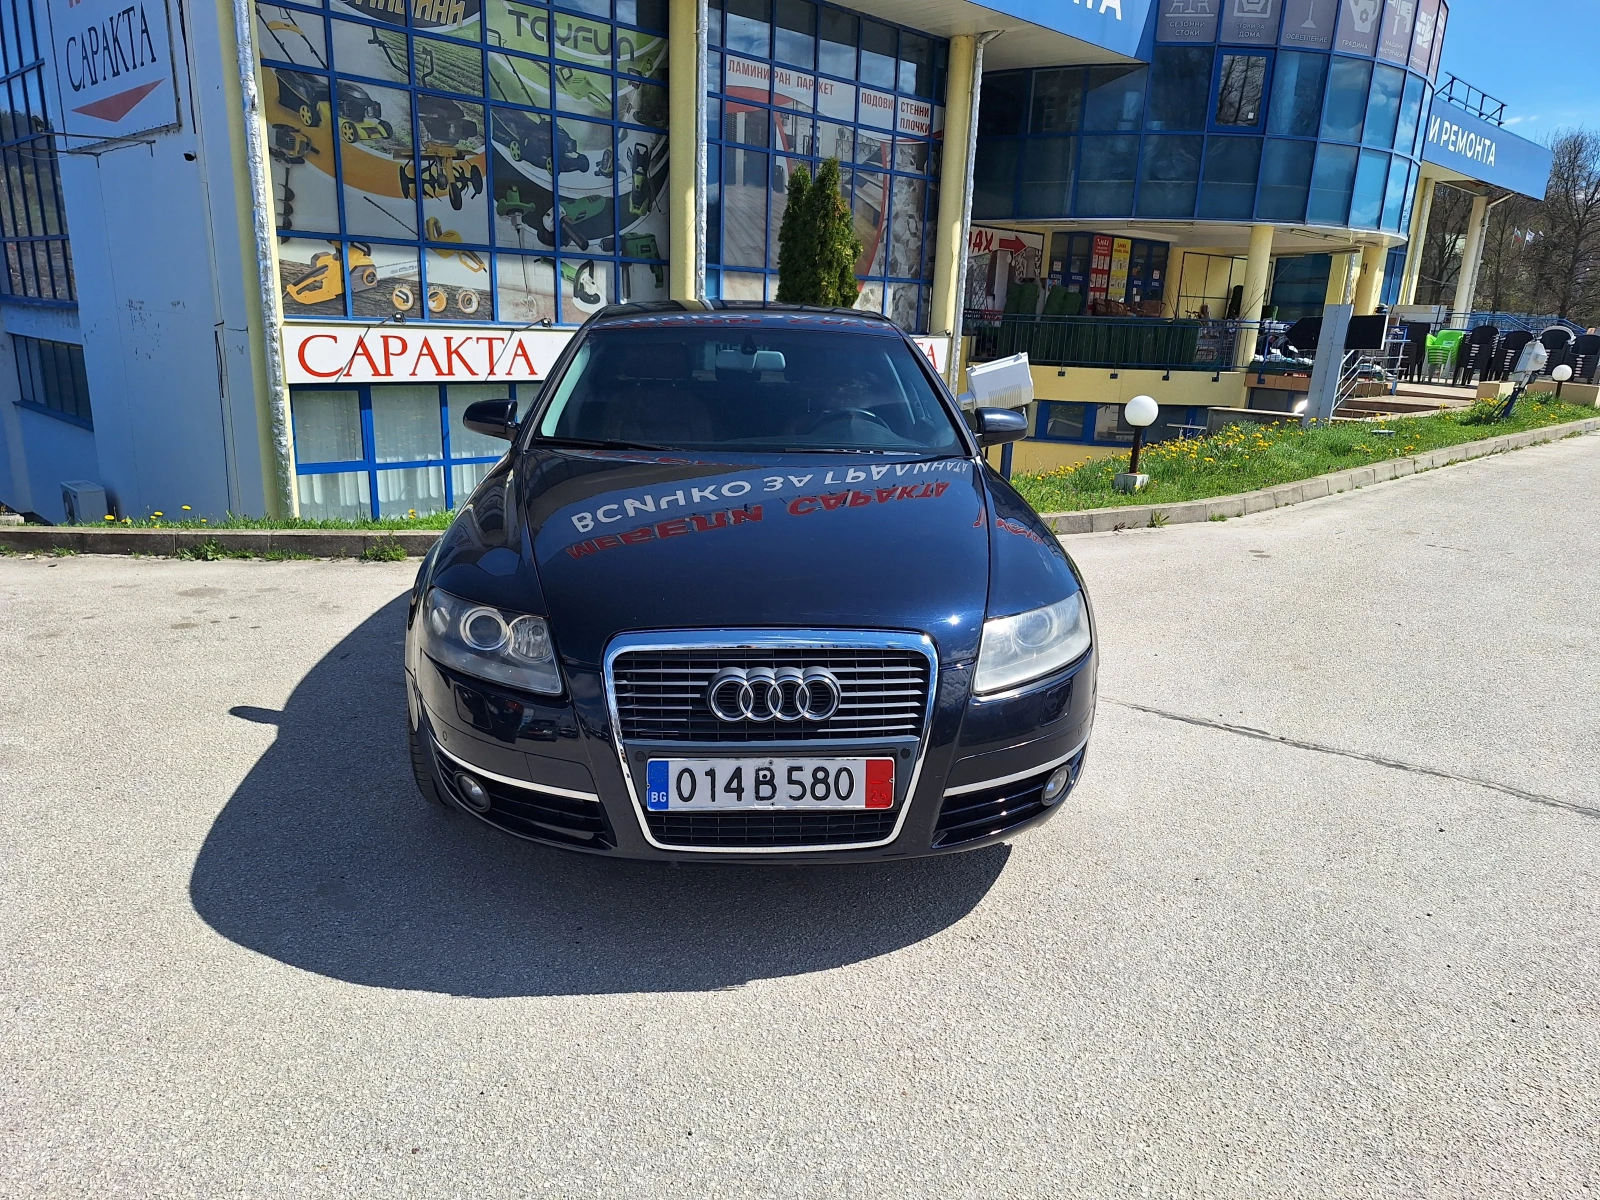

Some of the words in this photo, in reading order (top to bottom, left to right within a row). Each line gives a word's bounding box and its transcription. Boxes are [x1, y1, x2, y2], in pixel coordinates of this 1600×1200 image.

[1169, 20, 1205, 28] СЕЗОННИ
[1238, 30, 1261, 38] ДОМА
[1285, 32, 1328, 43] ОСВЕТЛЕНИЕ
[66, 1, 157, 92] САРАКТА
[1341, 39, 1369, 50] ГРАДИНА
[728, 59, 791, 86] ЛАМИНИРАН
[796, 75, 834, 96] ПАРКЕТ
[861, 92, 893, 111] ПОДОВИ
[900, 101, 930, 119] СТЕННИ
[899, 117, 930, 134] ПЛОЧКИ
[1428, 114, 1441, 144] И
[1440, 120, 1496, 167] РЕМОНТА
[297, 333, 539, 378] САРАКТА
[651, 791, 667, 803] BG
